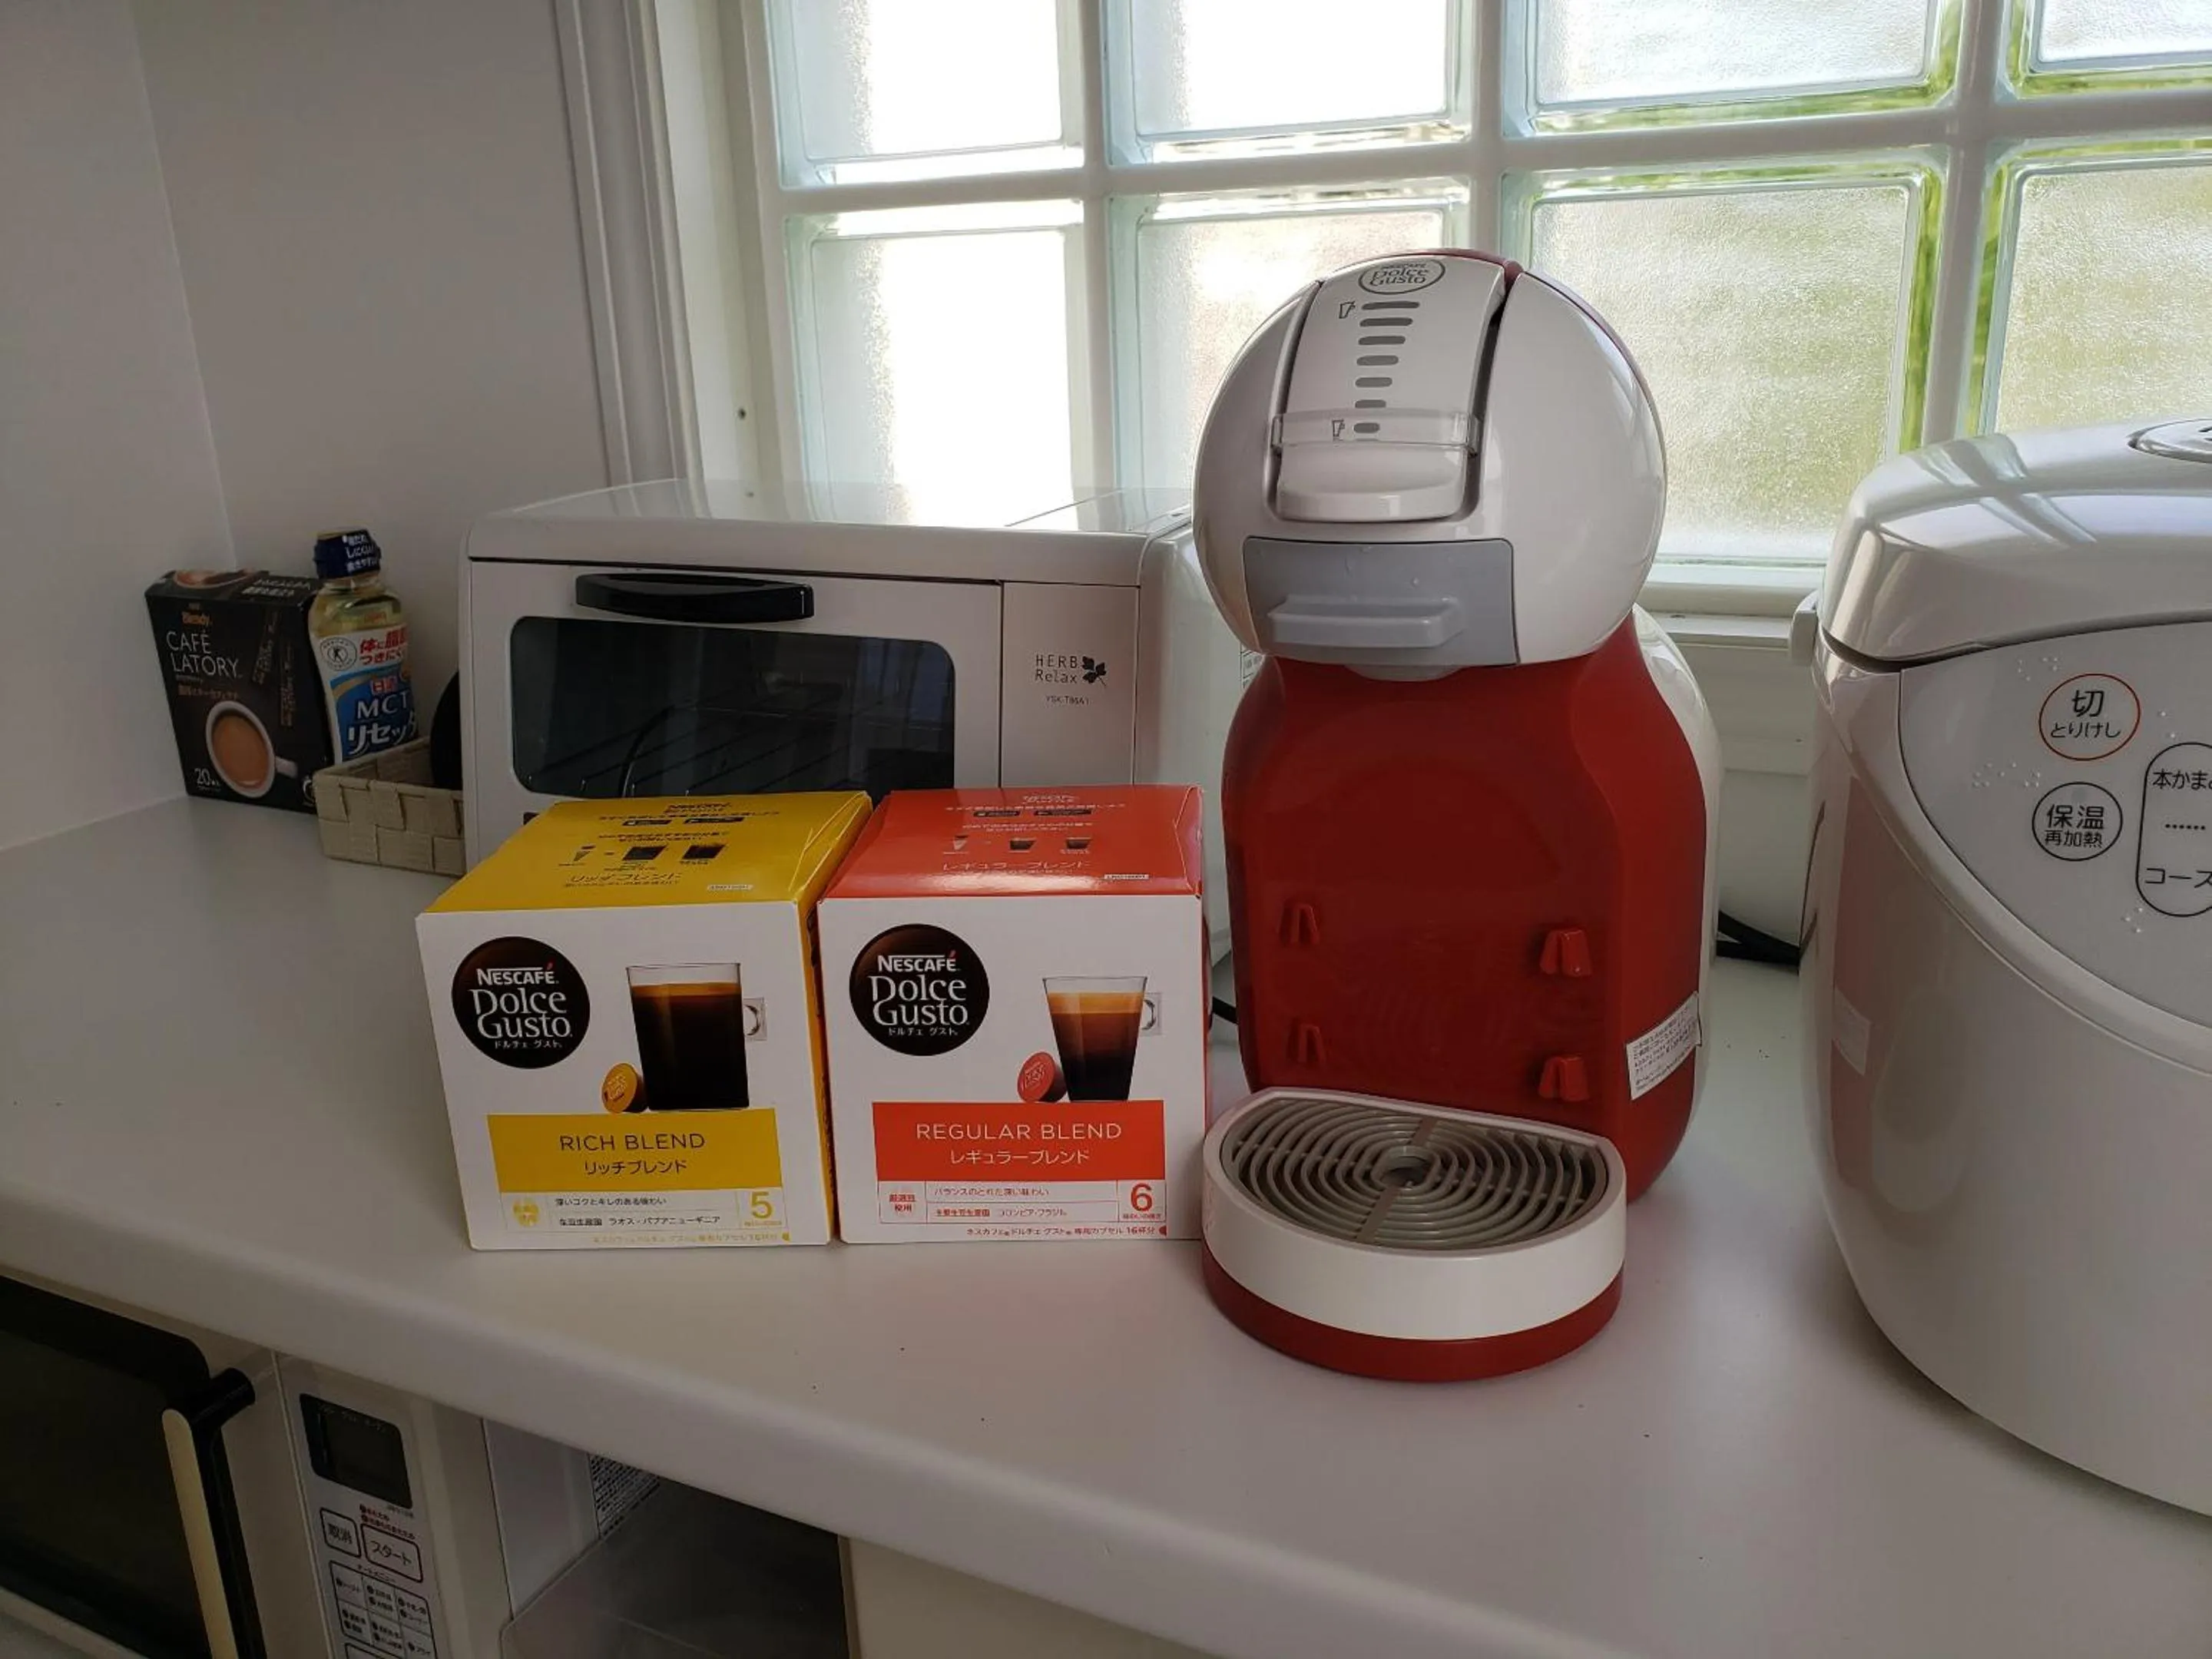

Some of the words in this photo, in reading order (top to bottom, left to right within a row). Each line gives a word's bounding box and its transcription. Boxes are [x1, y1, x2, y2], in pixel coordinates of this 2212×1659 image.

[1369, 276, 1426, 286] Gusto
[171, 651, 240, 680] LATORY
[1035, 654, 1078, 669] HERB
[1035, 668, 1078, 684] Relax
[356, 689, 412, 720] MCT
[2071, 690, 2104, 717] 切
[2050, 721, 2122, 739] とりけし
[2152, 768, 2212, 790] 本かま
[2046, 804, 2105, 830] 保温
[2044, 829, 2103, 849] 再加熱
[2144, 867, 2212, 889] コース
[877, 950, 958, 973] NESCAFÉ
[477, 962, 555, 985] NESCAFÉ
[469, 987, 567, 1016] Dolce
[868, 975, 968, 1005] Dolce
[873, 999, 969, 1026] Gusto
[477, 1012, 572, 1039] Gusto
[559, 1134, 615, 1153] RICH
[624, 1132, 707, 1151] BLEND
[916, 1123, 1031, 1141] REGULAR
[1041, 1122, 1123, 1141] BLEND
[584, 1158, 688, 1177] リッチブレンド
[949, 1149, 1091, 1166] レギュラーブレンド
[750, 1190, 773, 1220] 5
[1130, 1182, 1154, 1212] 6
[369, 1540, 412, 1566] スタート
